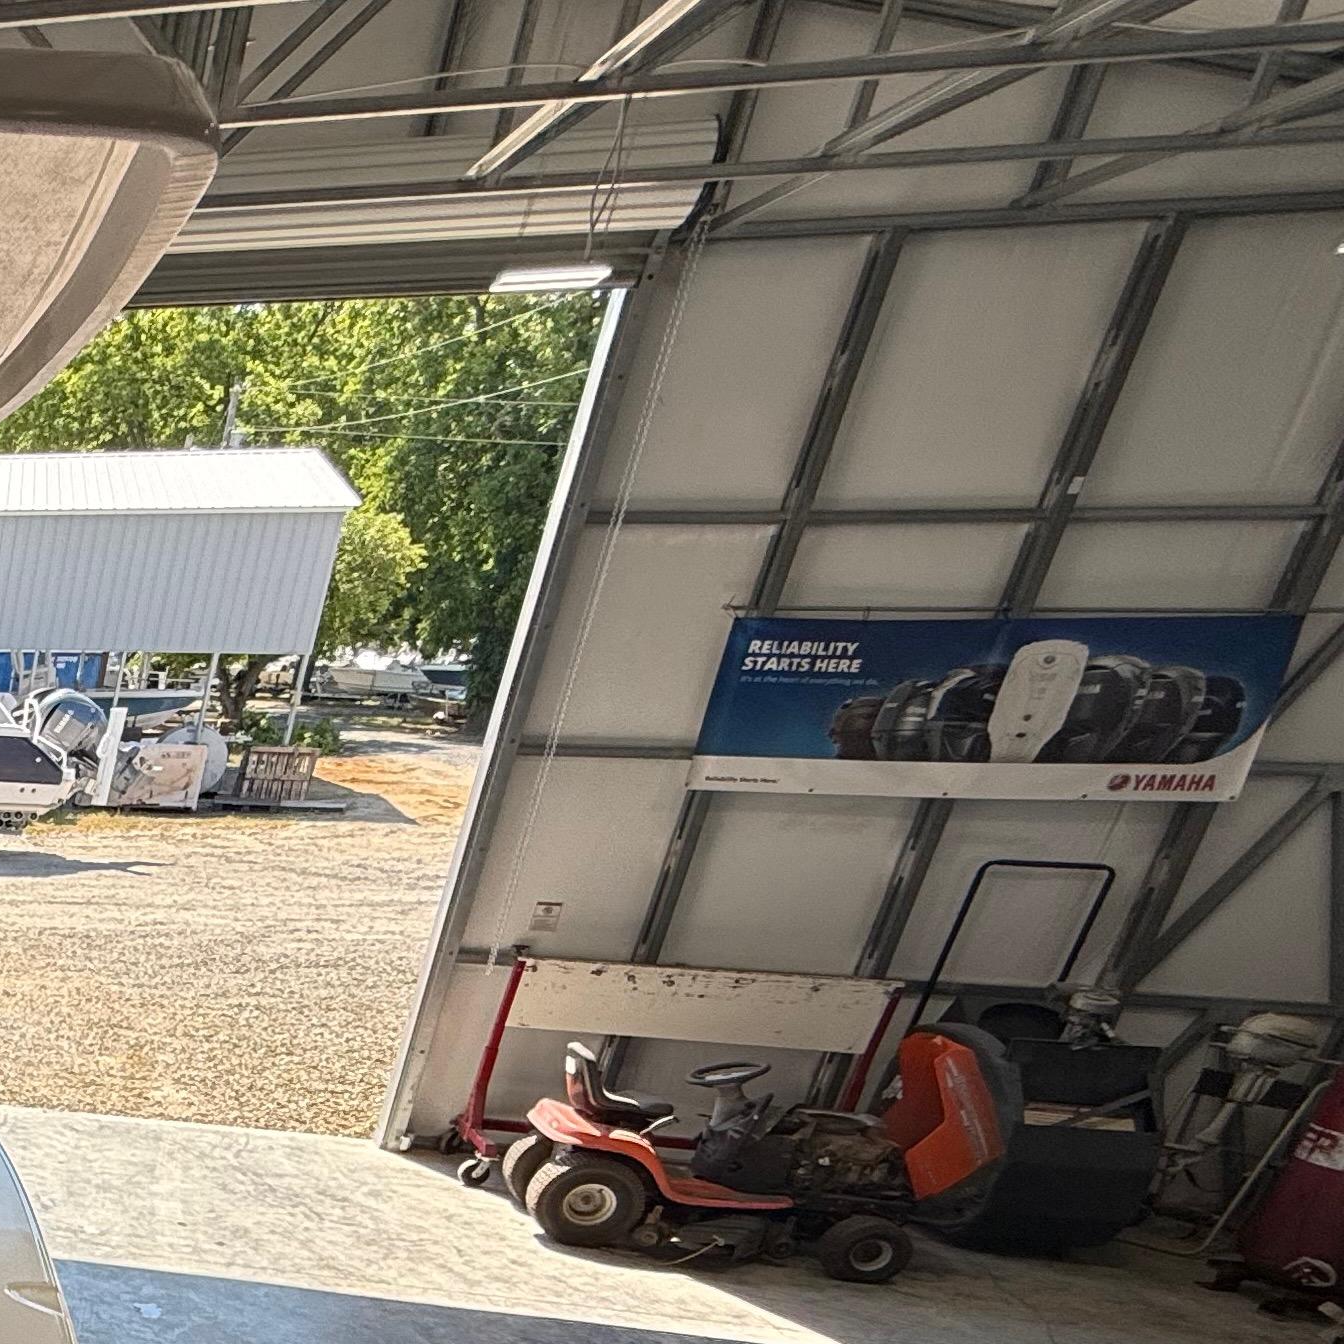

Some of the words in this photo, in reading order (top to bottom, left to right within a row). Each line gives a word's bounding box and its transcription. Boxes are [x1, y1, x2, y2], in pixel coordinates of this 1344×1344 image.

[747, 639, 860, 656] RELIABILITY
[741, 656, 811, 672] STARTS
[813, 658, 862, 673] HERE
[1133, 774, 1216, 791] YAMAHA
